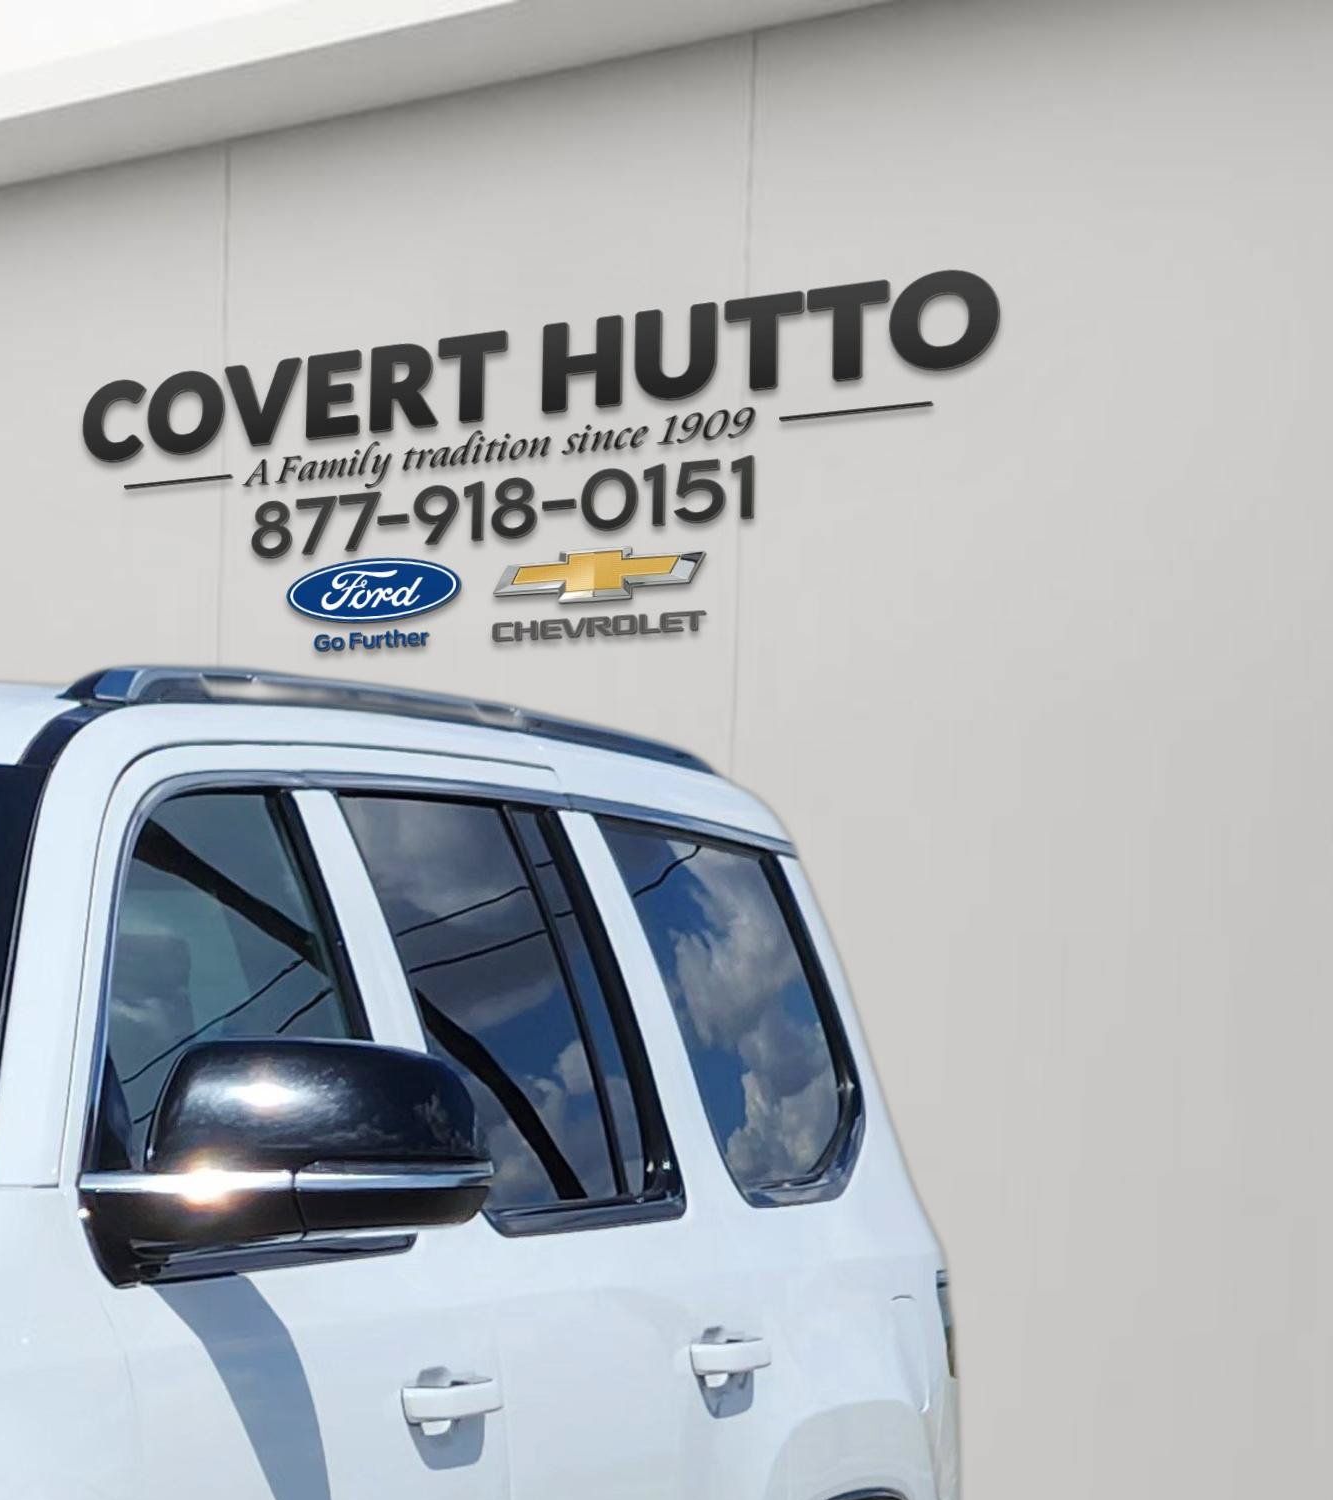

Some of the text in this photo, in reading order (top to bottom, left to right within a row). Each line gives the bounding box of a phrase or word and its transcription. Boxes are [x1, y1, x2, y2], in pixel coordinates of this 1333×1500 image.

[82, 269, 1001, 463] COVERT HUTTO
[243, 407, 756, 488] A Family tradition since 1909
[251, 455, 756, 559] 877-918-0151
[321, 569, 421, 612] Ford
[313, 628, 430, 652] Go Further
[491, 610, 707, 643] CHEVROLET
